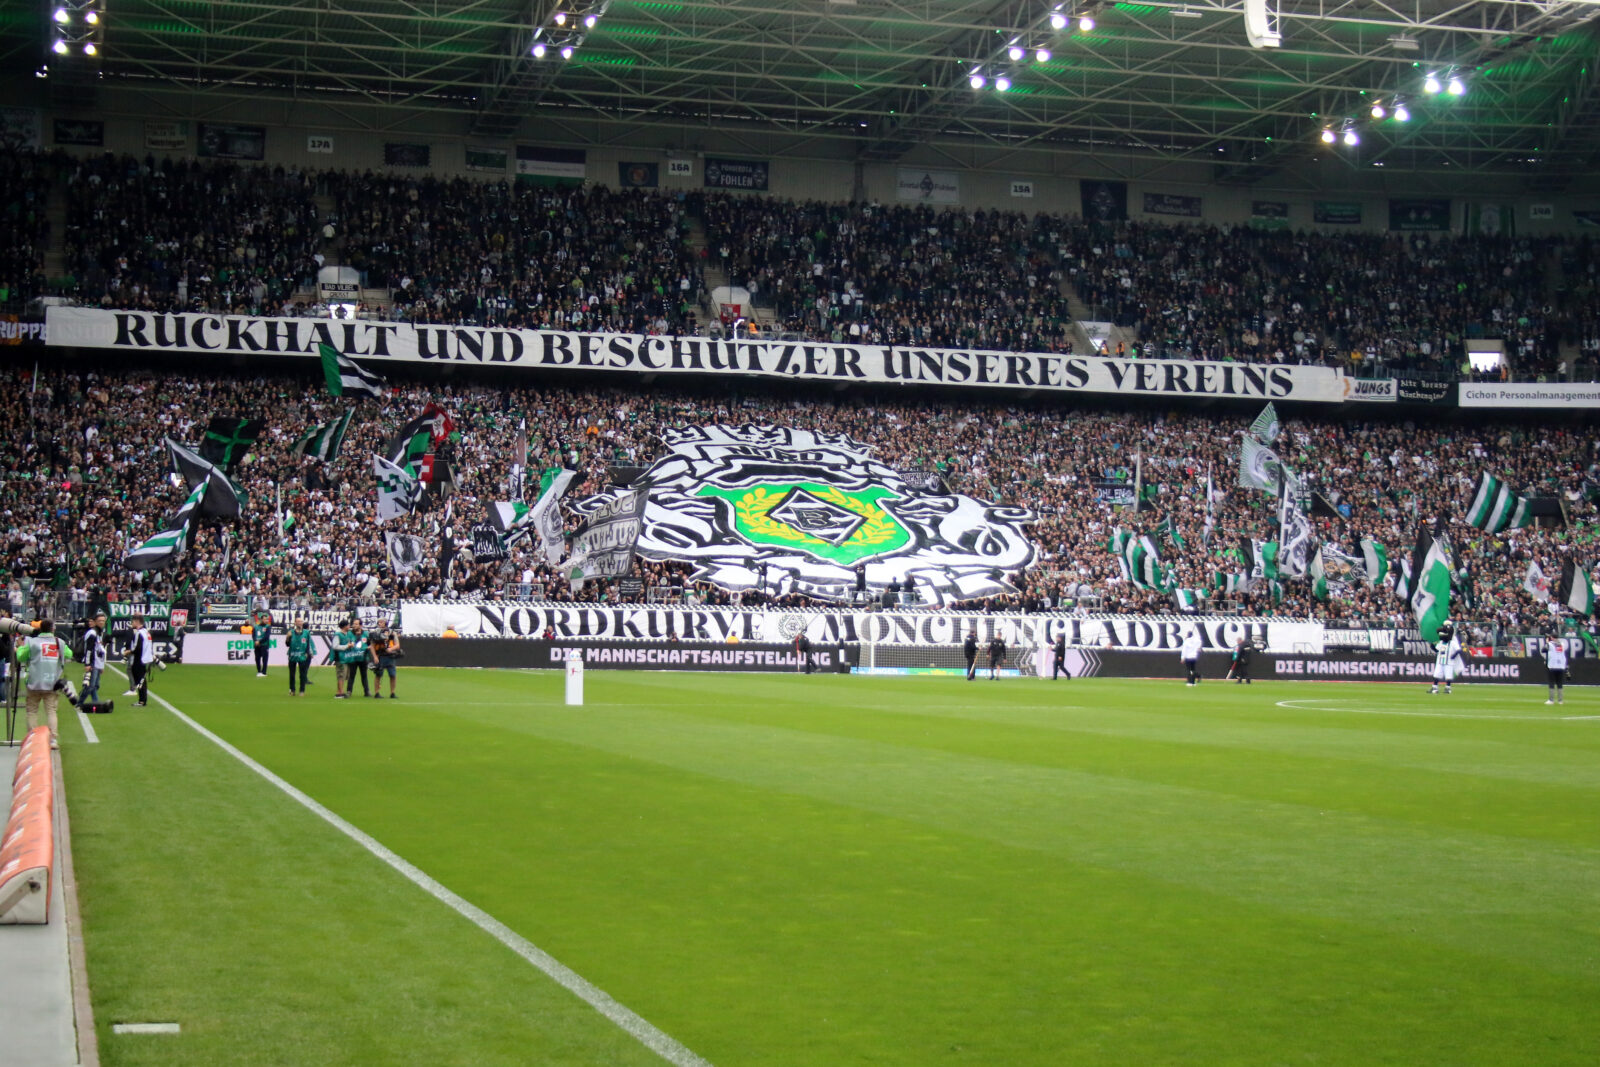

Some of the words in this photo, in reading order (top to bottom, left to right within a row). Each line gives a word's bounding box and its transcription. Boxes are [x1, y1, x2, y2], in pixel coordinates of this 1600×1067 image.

[671, 163, 690, 172] 16A
[1013, 185, 1031, 193] 15A
[416, 328, 524, 362] UND
[882, 349, 1089, 388] UNSERES
[1102, 361, 1293, 397] VEREINS
[1354, 382, 1392, 395] JUNGS
[1466, 390, 1497, 400] Cichon
[1500, 390, 1600, 402] Personalmanagement
[110, 603, 170, 616] FOHLEN
[476, 605, 764, 640] NORDKURVE
[227, 639, 277, 650] FOHN
[227, 650, 251, 660] ELF
[587, 648, 831, 667] MANNSCHAFTSAUFSTELLUNG
[1275, 659, 1304, 674] DIE
[1307, 660, 1520, 678] MANNSCHAFTSAUELLUNG
